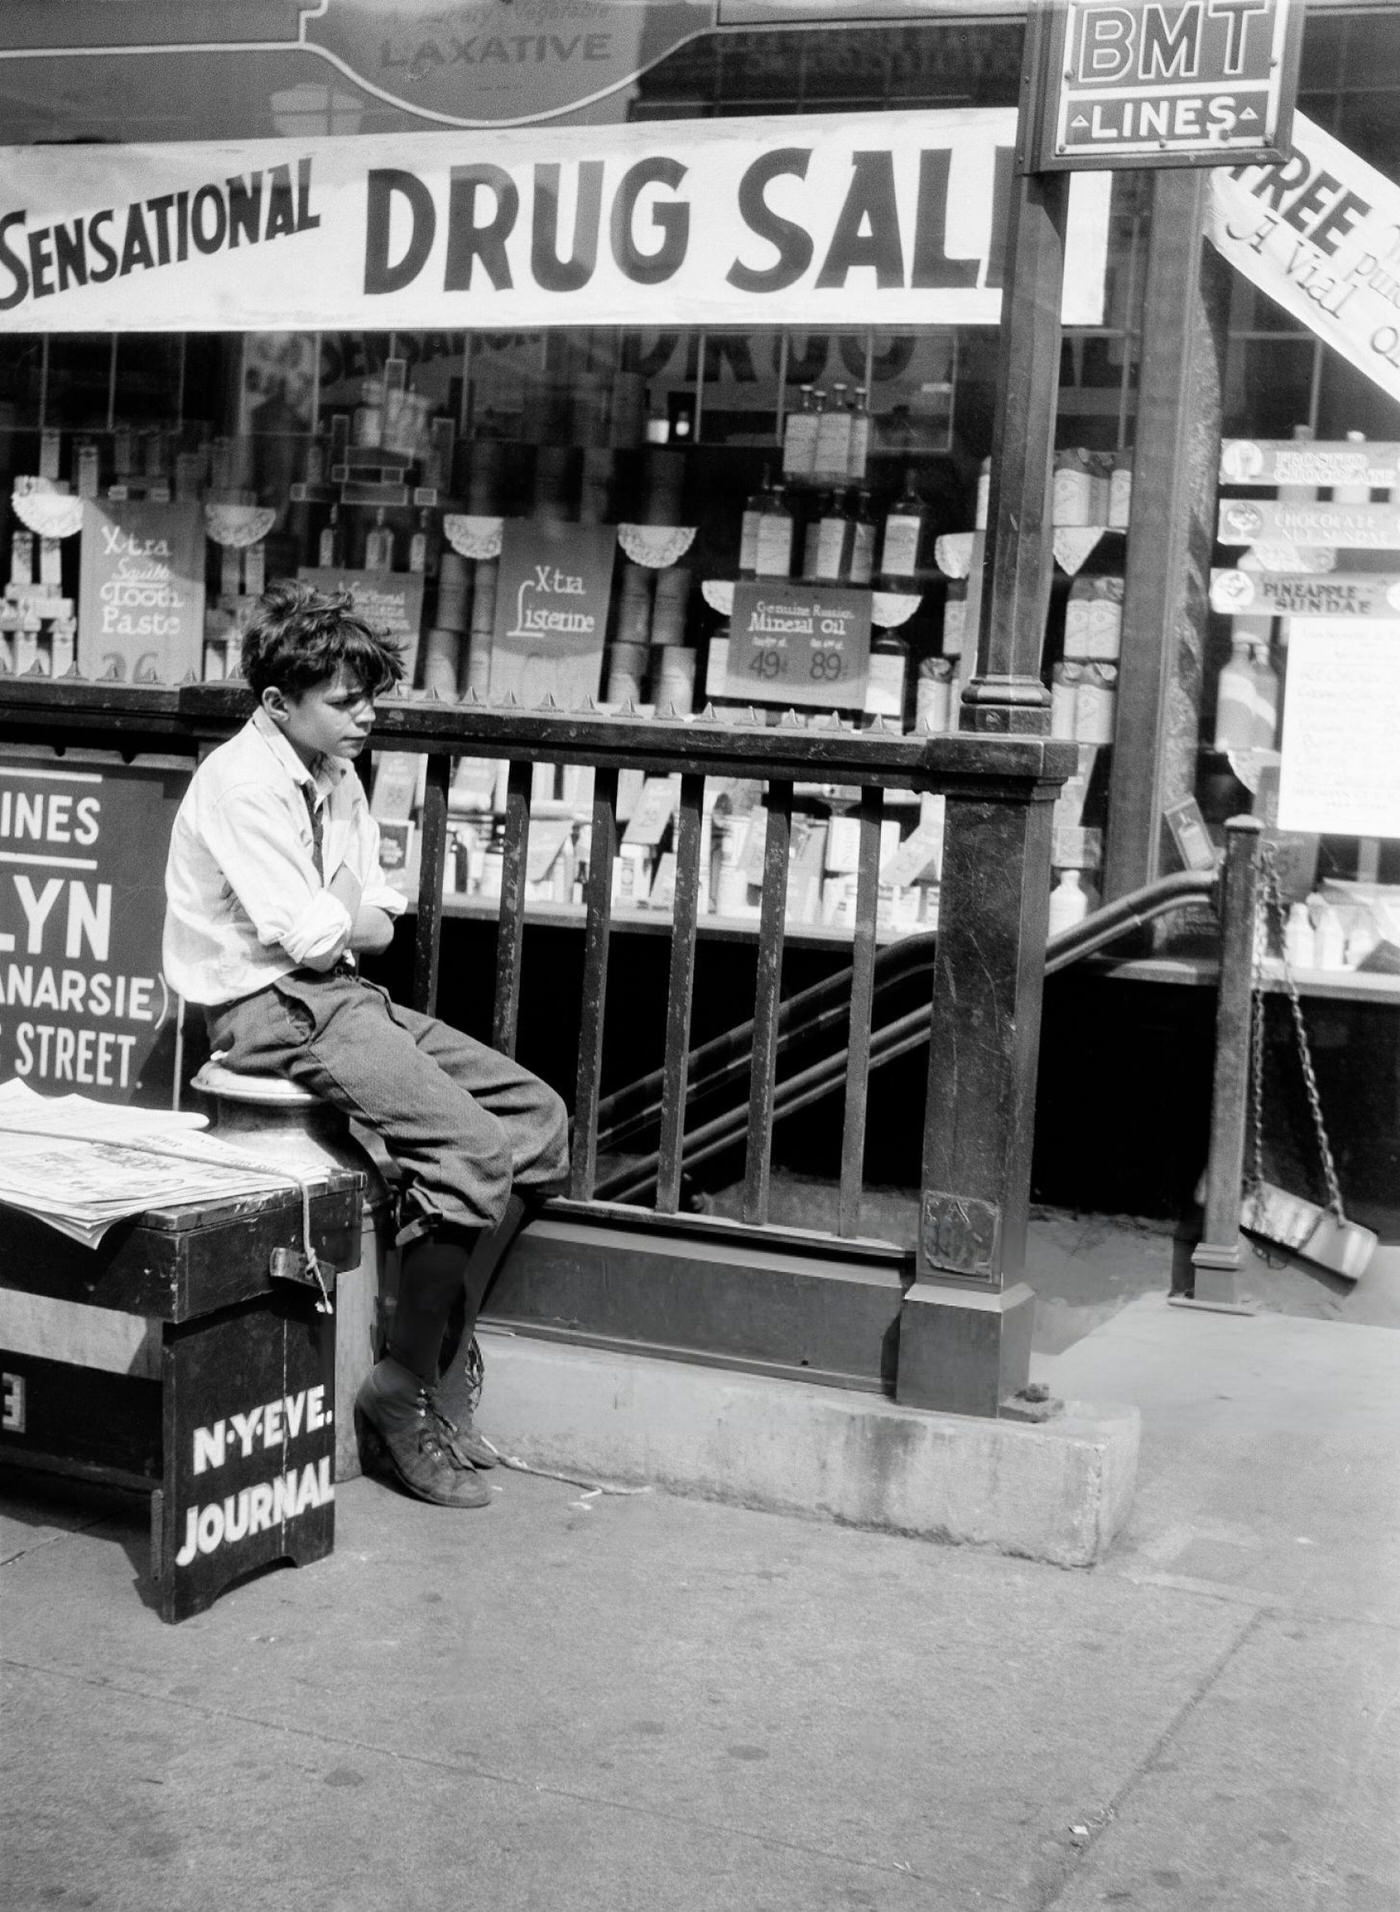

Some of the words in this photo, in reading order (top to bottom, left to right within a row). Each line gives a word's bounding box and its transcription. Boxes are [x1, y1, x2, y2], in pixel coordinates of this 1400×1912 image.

[380, 32, 613, 68] LAXATIVE
[1079, 0, 1269, 82] BMT
[1092, 97, 1236, 138] LINES
[0, 157, 320, 312] SENSATIONAL
[364, 157, 691, 295] DRUG
[726, 146, 1016, 293] SAL
[1286, 240, 1358, 319] Vial
[1274, 513, 1377, 529] CHOCOLATE
[99, 580, 184, 609] Tooth
[506, 579, 596, 638] Listerine
[1263, 581, 1358, 599] PINEAPPLE
[1275, 597, 1372, 615] SUNDAE
[100, 605, 182, 636] Paste
[748, 611, 814, 634] Mineral
[820, 617, 847, 636] Oil
[0, 874, 112, 962] YN
[0, 964, 168, 1031] NARSIE)
[175, 1455, 335, 1566] JOURNAL
